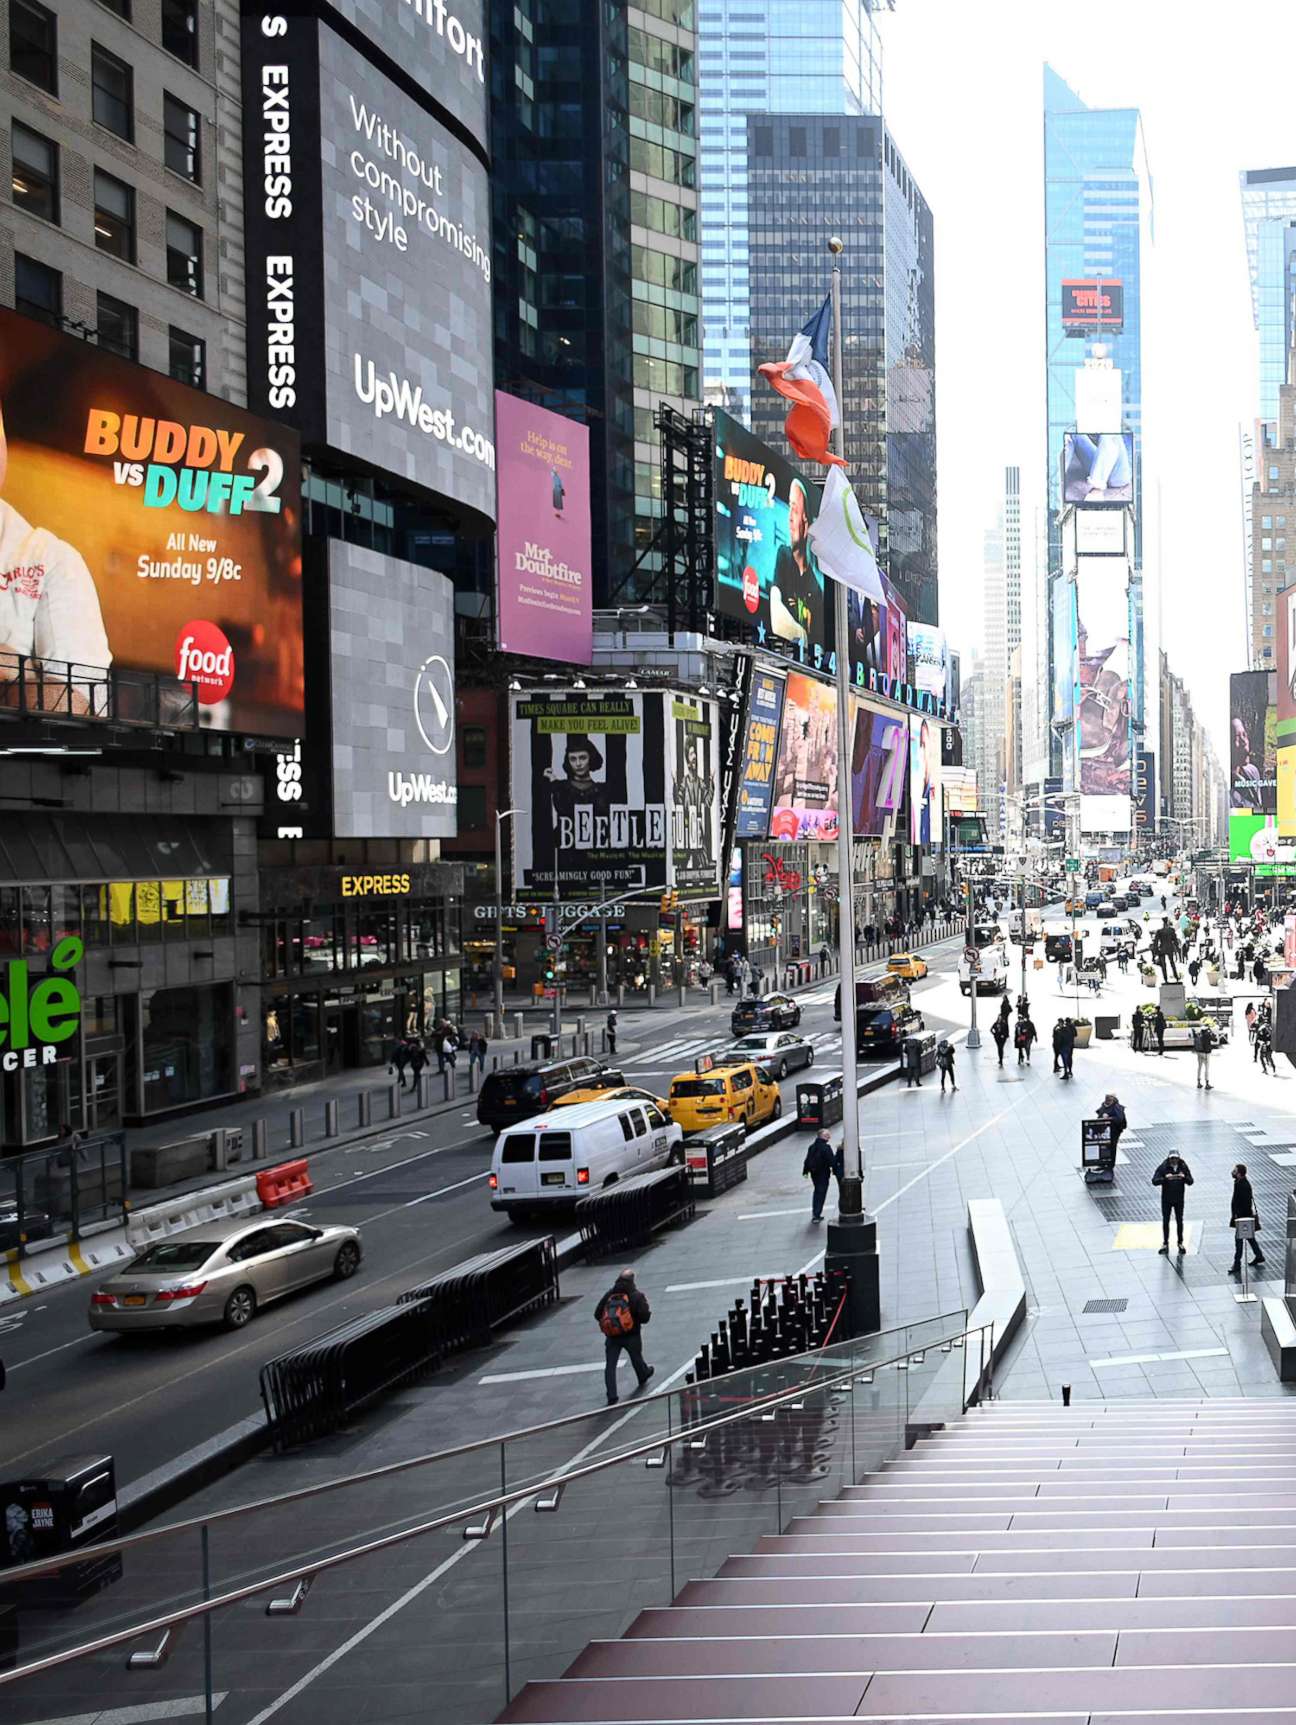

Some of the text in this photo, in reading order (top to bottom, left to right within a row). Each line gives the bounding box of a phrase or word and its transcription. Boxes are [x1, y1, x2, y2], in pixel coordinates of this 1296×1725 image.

[261, 65, 292, 219] EXPRESS
[350, 95, 442, 196] Without
[351, 151, 492, 283] compromising
[351, 192, 409, 252] style
[266, 255, 296, 409] EXPRESS
[354, 354, 495, 471] UpWest.com
[84, 408, 245, 472] BUDDY
[244, 447, 284, 513] 2
[724, 455, 766, 487] BUDDY
[113, 461, 256, 515] VS DUFF
[165, 532, 217, 553] All New
[137, 554, 242, 586] Sunday 9/8c
[515, 552, 583, 585] Doubtfire
[177, 636, 233, 681] food
[519, 700, 631, 716] TIMES SQUARE CAN REALLY
[540, 718, 639, 732] MAKE YOU FEEL ALIVE!
[1234, 780, 1256, 788] MUSIC
[342, 873, 411, 897] EXPRESS
[590, 870, 612, 880] GOOD
[31, 1507, 54, 1519] ERIKA
[32, 1518, 54, 1529] JAYNE
